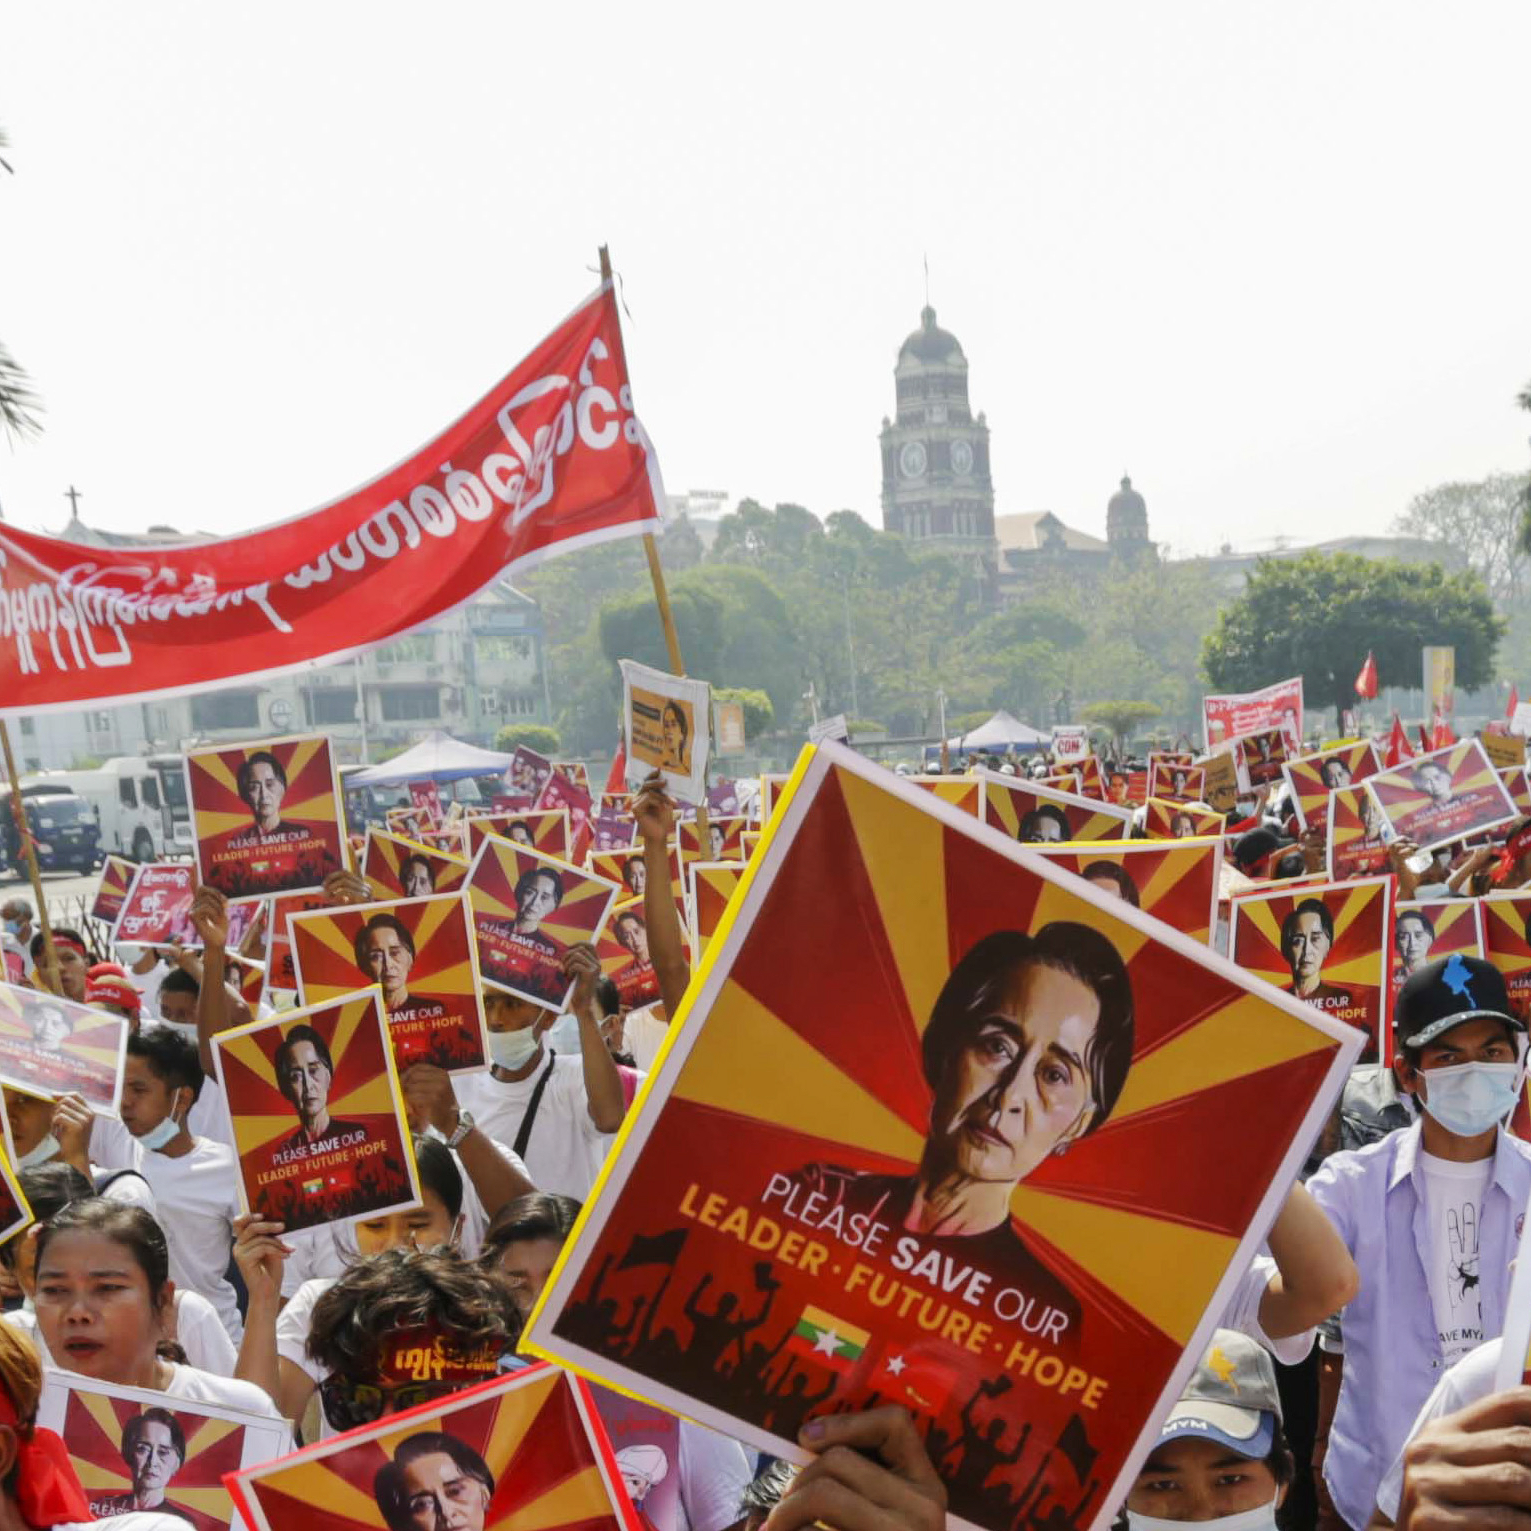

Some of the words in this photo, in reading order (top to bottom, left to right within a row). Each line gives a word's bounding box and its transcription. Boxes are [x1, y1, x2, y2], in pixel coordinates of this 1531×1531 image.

[227, 837, 258, 849] PLEASE
[260, 833, 287, 844] SAVE
[288, 830, 309, 840] OUR
[212, 851, 250, 863] LEADER
[255, 844, 294, 856] FUTURE
[298, 839, 326, 850] HOPE
[1325, 995, 1349, 1008] OUR
[386, 1009, 415, 1024] SAVE
[418, 1005, 443, 1020] OUR
[1336, 1007, 1367, 1019] HOPE
[387, 1021, 425, 1034] UTURE
[430, 1015, 464, 1029] HOPE
[272, 1146, 309, 1165] PLEASE
[309, 1137, 339, 1155] SAVE
[340, 1129, 366, 1145] OUR
[256, 1164, 300, 1185] LEADER
[305, 1151, 350, 1171] FUTURE
[355, 1140, 388, 1157] HOPE
[759, 1172, 893, 1257] PLEASE
[888, 1234, 995, 1309] SAVE
[992, 1285, 1071, 1346] OUR
[677, 1182, 833, 1277] LEADER
[842, 1264, 992, 1354] FUTURE
[1003, 1341, 1111, 1409] HOPE
[1161, 1419, 1209, 1436] MYM
